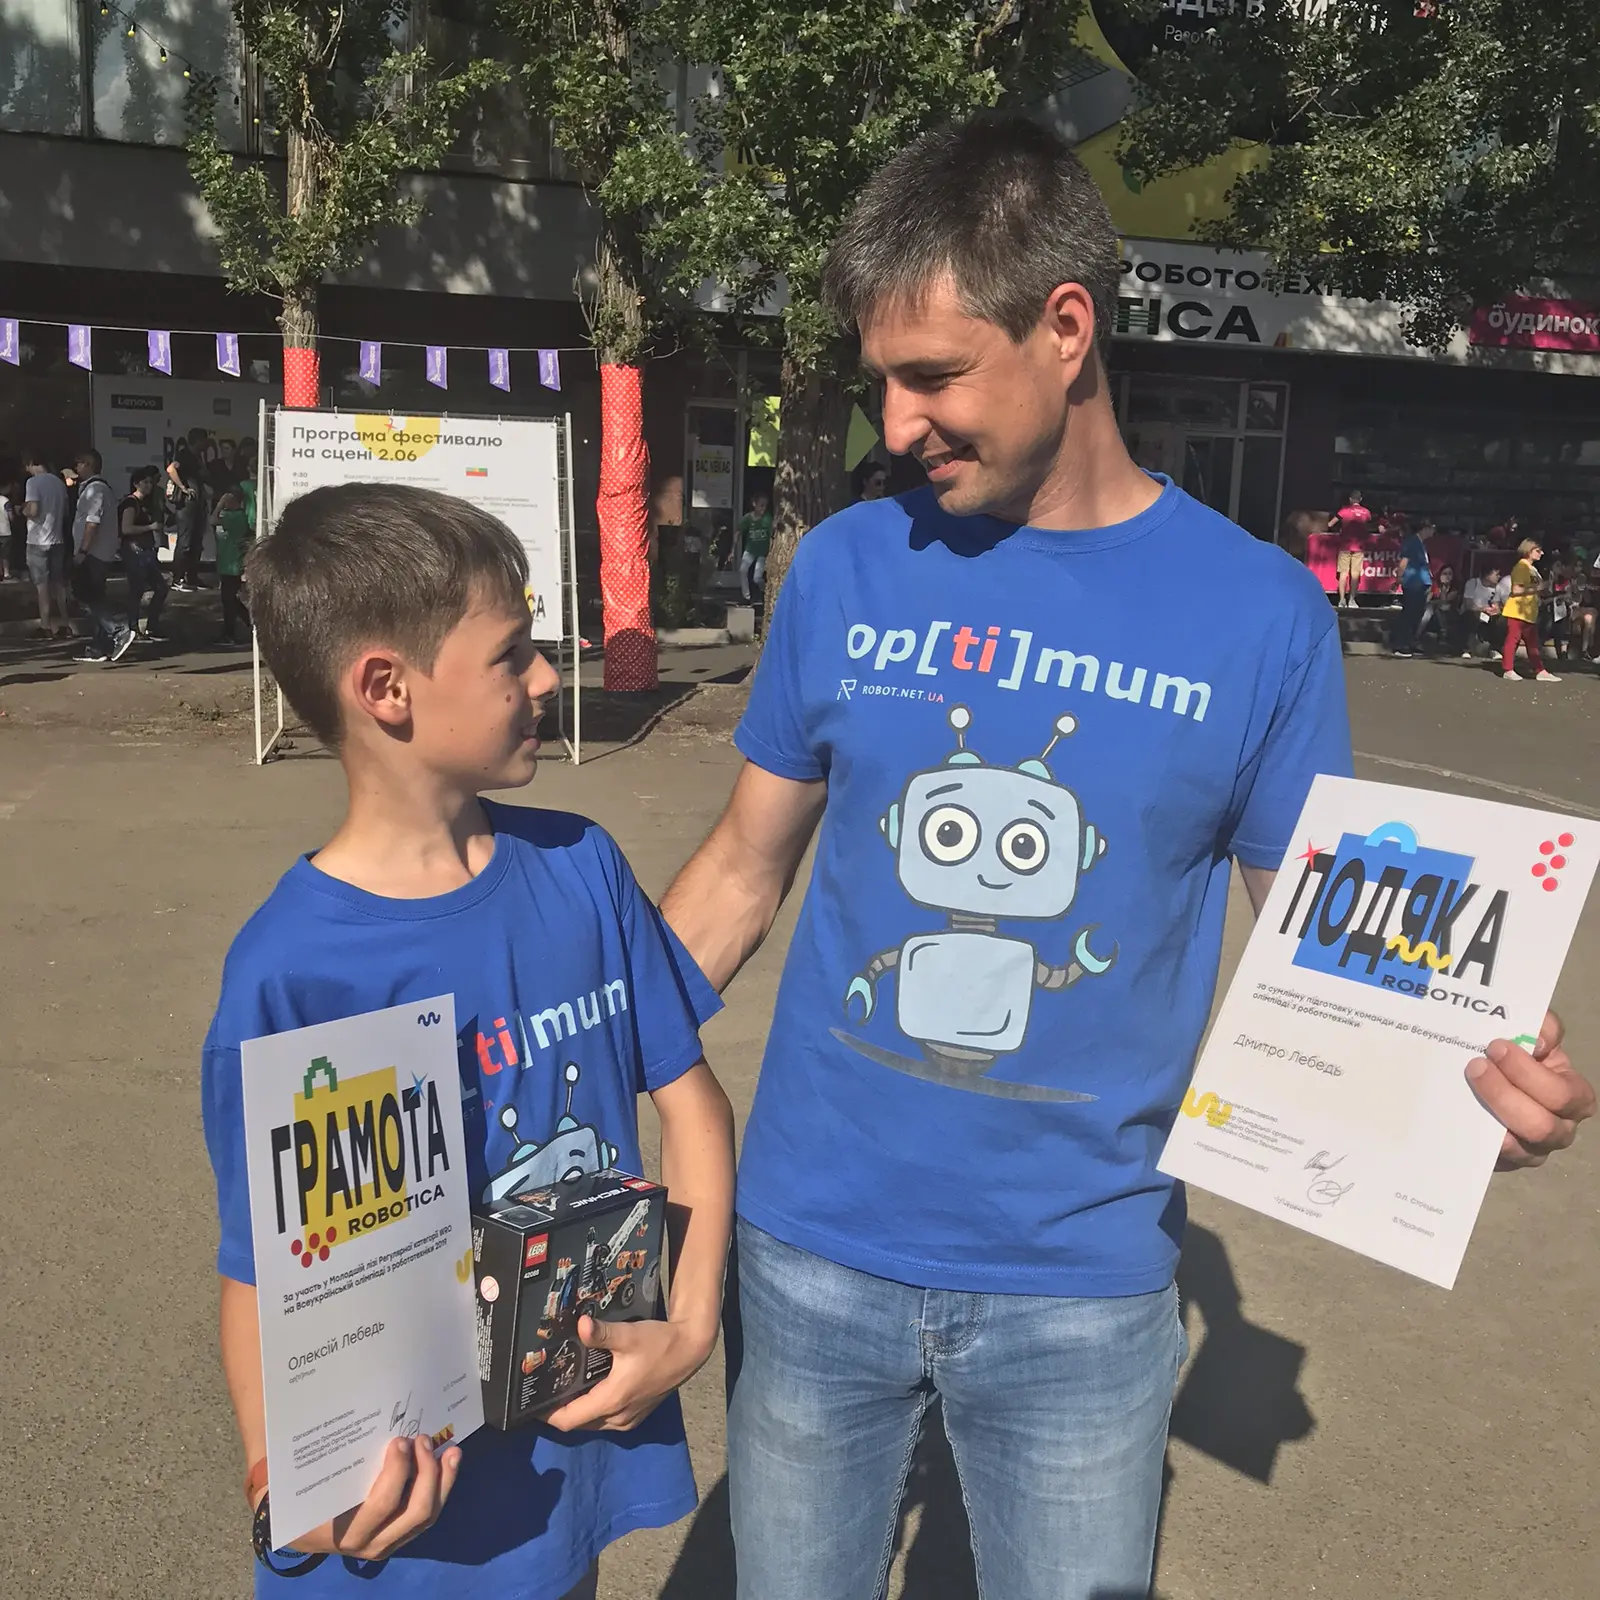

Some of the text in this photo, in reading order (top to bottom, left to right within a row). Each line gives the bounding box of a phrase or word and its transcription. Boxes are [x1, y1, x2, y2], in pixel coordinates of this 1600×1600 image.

[291, 426, 503, 447] Програма фестивалю
[291, 446, 417, 462] на сцені 2.06
[846, 620, 1213, 723] op[ti]mum
[861, 684, 945, 704] ROBOT.NET.UA
[1279, 852, 1510, 987] ПОДЯКА
[1252, 992, 1291, 1009] олімпіаді
[1296, 1004, 1361, 1029] робототехніки
[1256, 983, 1267, 991] за
[1267, 985, 1305, 1002] сумлінну
[1306, 994, 1353, 1016] підготовку
[1354, 1010, 1395, 1027] команди
[1395, 1021, 1409, 1032] до
[1380, 973, 1508, 1021] ROBOTICA
[1232, 1033, 1342, 1077] Дмитро Лебедь
[270, 1079, 450, 1235] ГРАМОТА
[347, 1183, 446, 1236] ROBOTICA
[569, 1187, 630, 1209] TECHNIC
[283, 1292, 294, 1304] За
[294, 1282, 322, 1302] участь
[329, 1263, 366, 1285] Молодшій
[365, 1258, 378, 1273] лізі
[378, 1244, 413, 1265] Регулярної
[412, 1230, 439, 1250] категорії
[438, 1223, 453, 1238] WRO
[526, 1241, 549, 1260] LEGO
[283, 1305, 295, 1316] на
[296, 1278, 354, 1311] Всеукраїнській
[354, 1268, 386, 1287] олімпіаді
[391, 1246, 434, 1273] робототехніки
[434, 1236, 448, 1251] 2019
[287, 1321, 385, 1371] Олексій Лебедь
